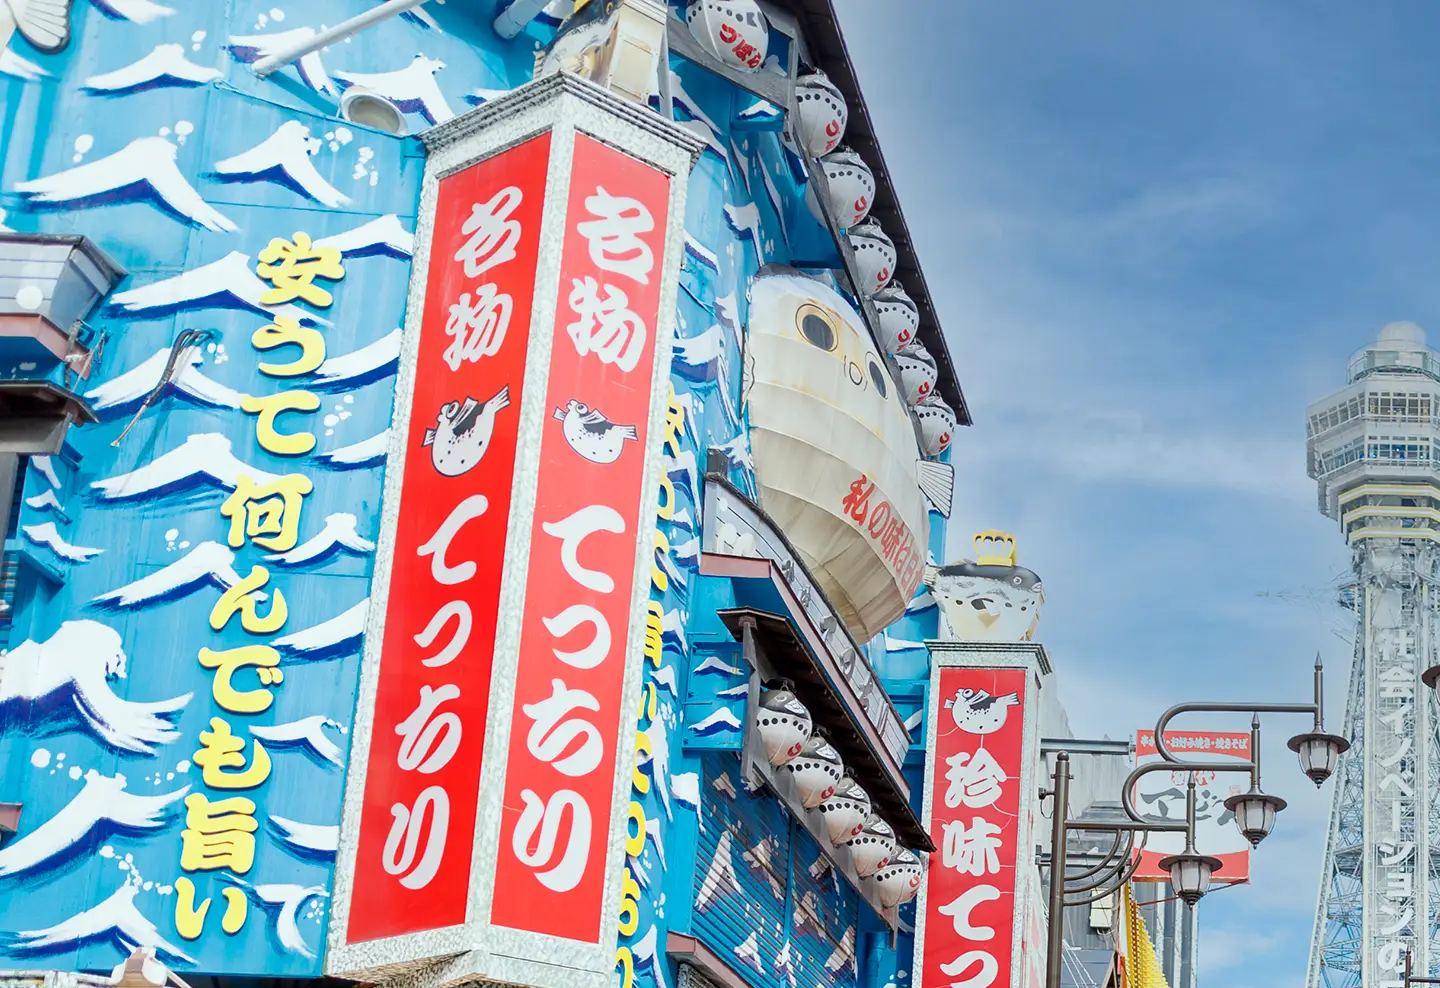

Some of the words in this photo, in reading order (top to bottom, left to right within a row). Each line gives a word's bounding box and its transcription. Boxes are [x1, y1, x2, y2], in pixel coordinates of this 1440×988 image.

[175, 231, 345, 940] 安うて何んでも旨い
